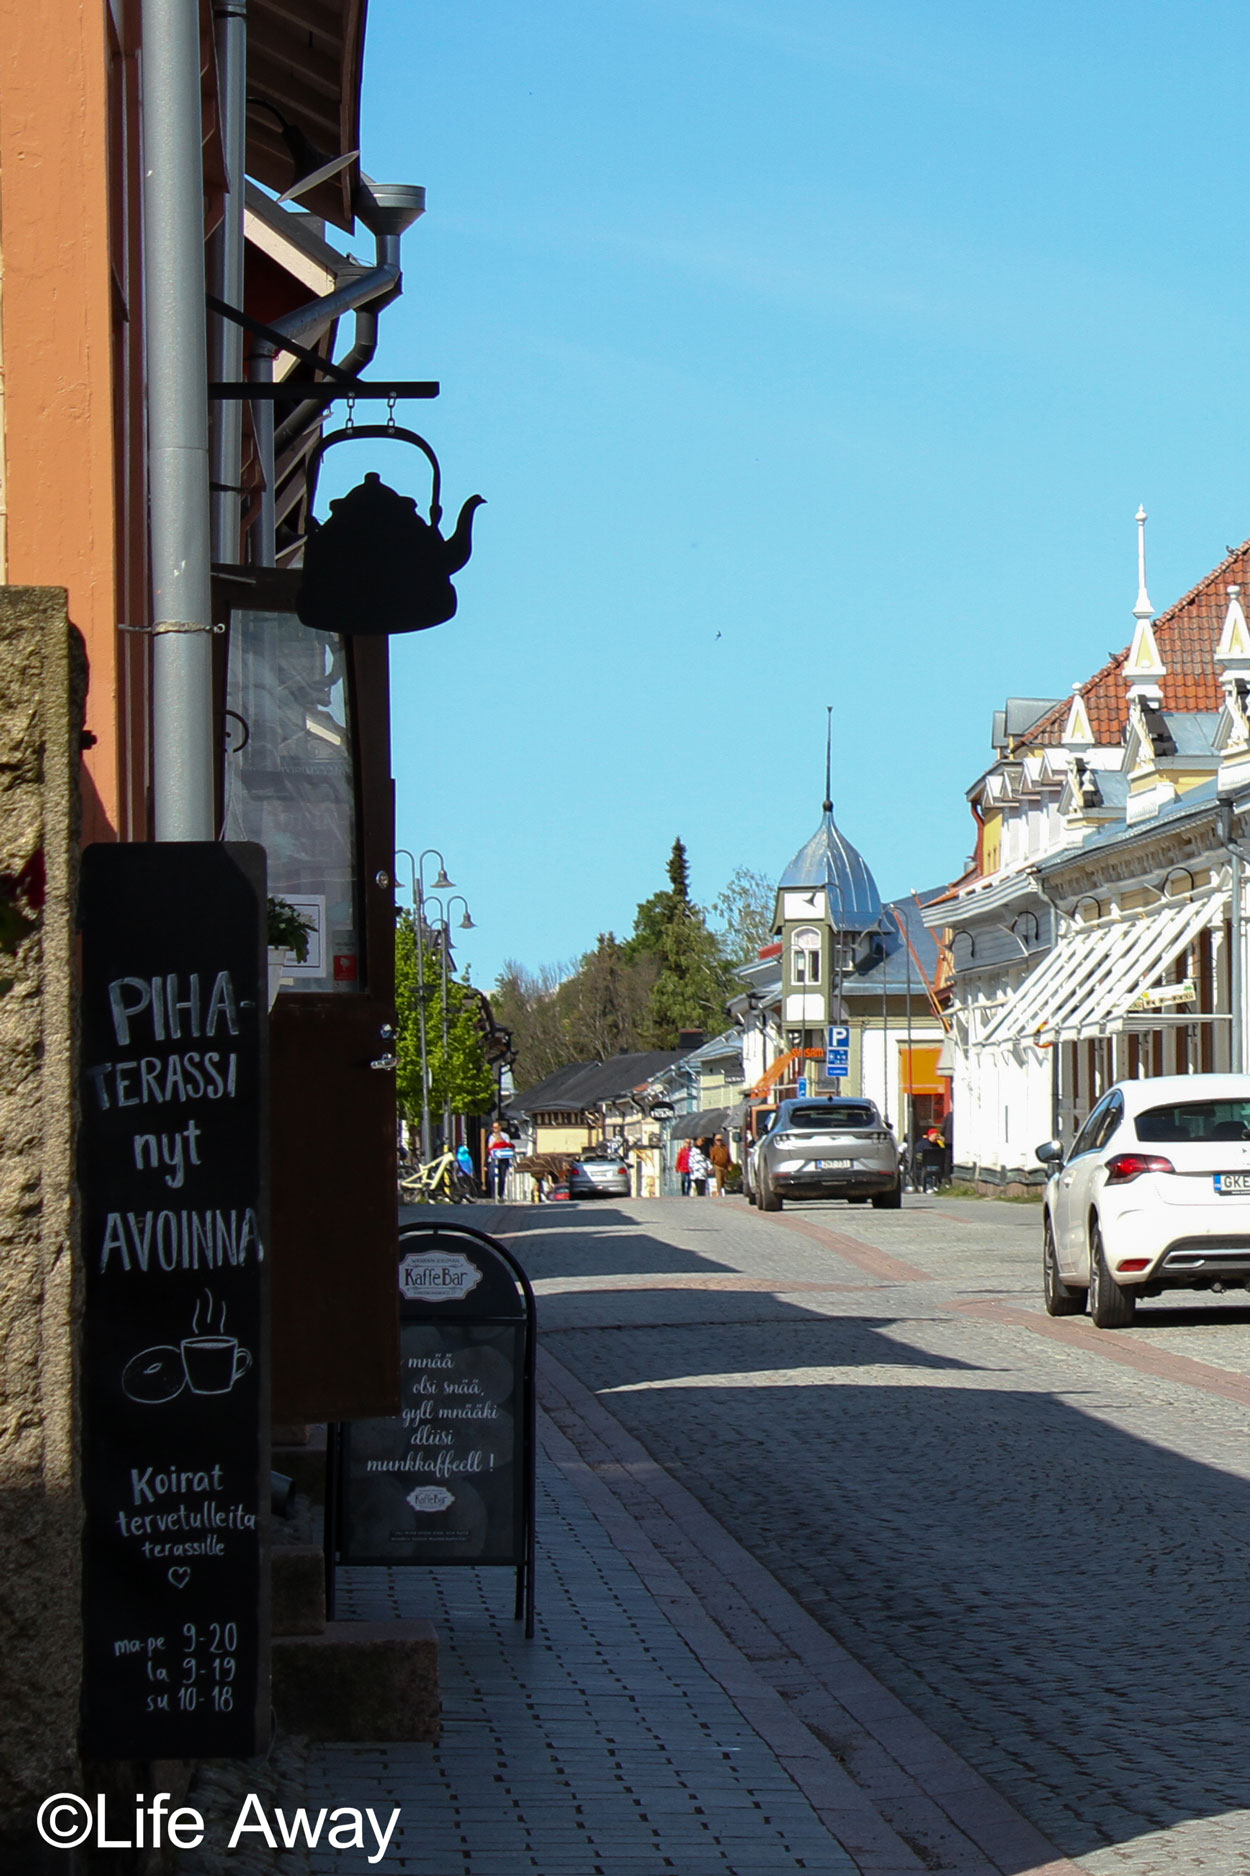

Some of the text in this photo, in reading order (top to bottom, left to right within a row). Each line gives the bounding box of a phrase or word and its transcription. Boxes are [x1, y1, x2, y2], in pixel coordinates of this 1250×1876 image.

[108, 969, 257, 1046] PIHA-
[832, 1028, 848, 1047] P
[88, 1051, 238, 1110] TERASSI
[133, 1119, 201, 1189] nyt
[100, 1207, 265, 1274] AVOINNA
[404, 1267, 469, 1286] KaffeBar
[408, 1353, 455, 1368] mnää
[402, 1400, 499, 1428] gyll mnääki
[129, 1463, 224, 1506] Koirat
[115, 1501, 257, 1537] tervetulleita
[141, 1533, 225, 1559] terassille
[113, 1622, 238, 1657] ma-pe 9-20
[146, 1657, 237, 1685] la 9-19
[145, 1693, 170, 1713] su
